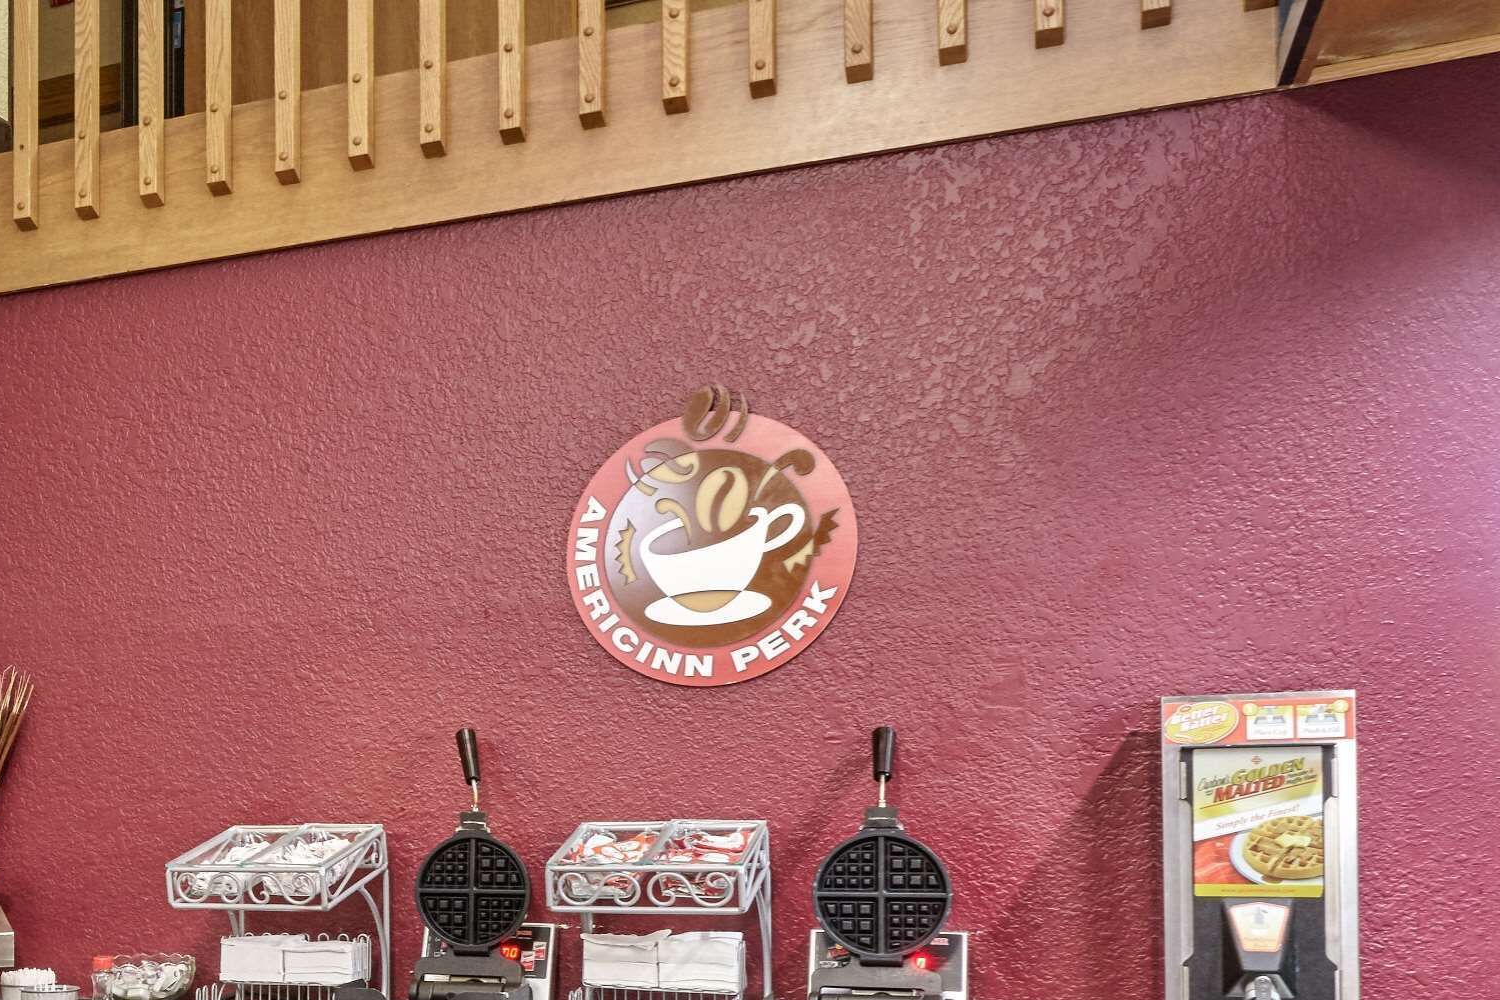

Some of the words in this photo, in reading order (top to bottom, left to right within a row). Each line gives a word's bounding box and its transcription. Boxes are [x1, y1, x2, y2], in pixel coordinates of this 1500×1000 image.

[574, 496, 714, 677] AMERICINN
[730, 580, 838, 673] PERK
[1231, 756, 1306, 785] GOLDEN
[1213, 775, 1286, 803] MALTED
